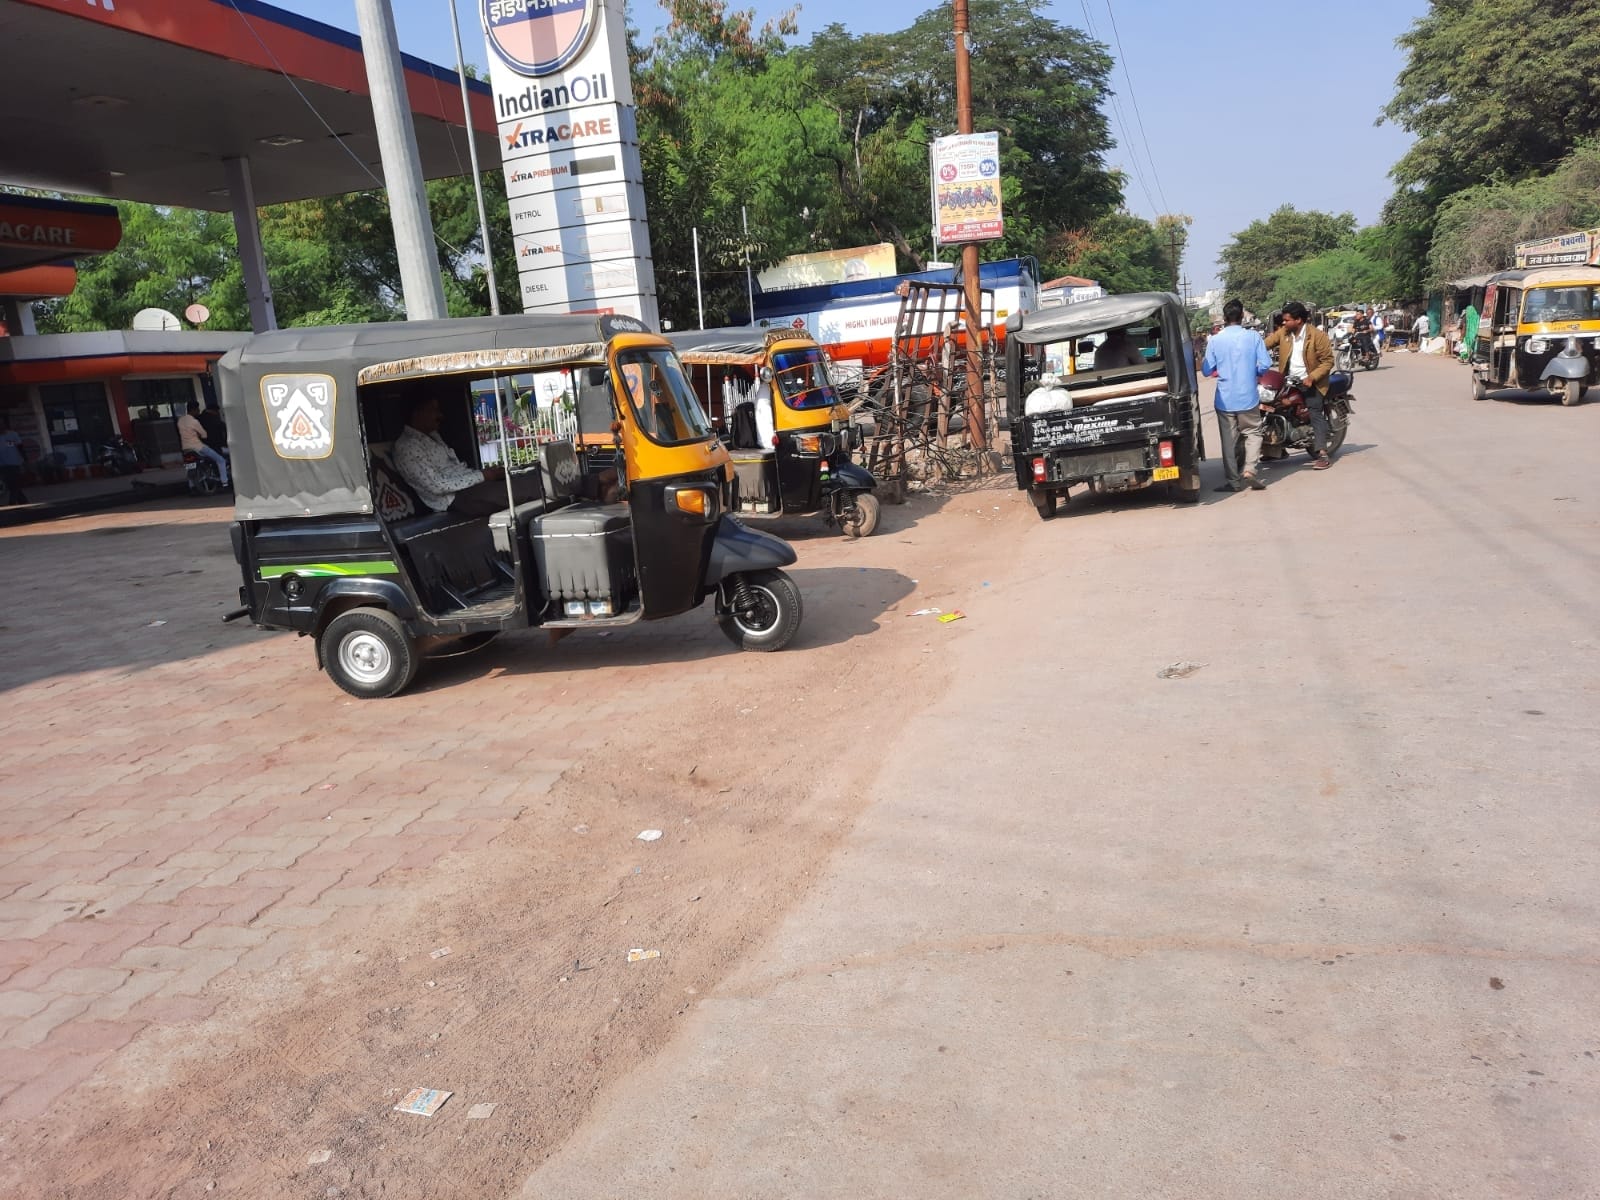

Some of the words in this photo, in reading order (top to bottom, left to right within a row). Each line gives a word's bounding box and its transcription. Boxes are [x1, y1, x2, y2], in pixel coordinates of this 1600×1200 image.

[499, 73, 607, 117] IndianOil
[506, 118, 612, 150] XTRACARE
[515, 209, 542, 220] PETROL
[525, 284, 549, 294] DIESEL
[845, 319, 868, 329] HIGHLY
